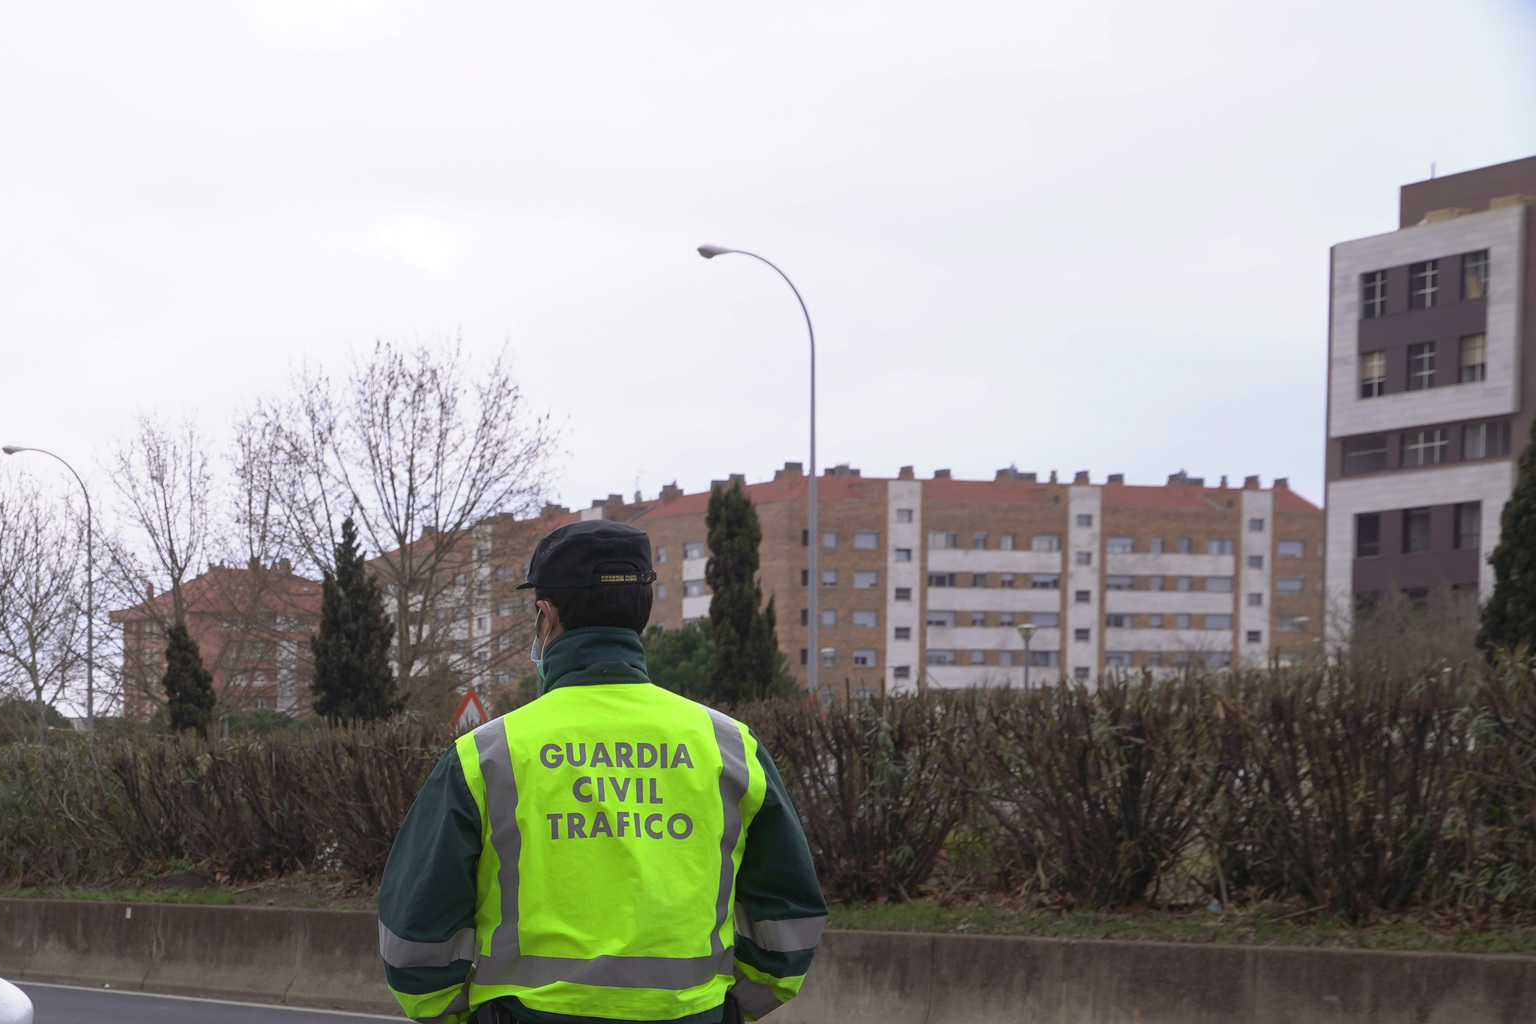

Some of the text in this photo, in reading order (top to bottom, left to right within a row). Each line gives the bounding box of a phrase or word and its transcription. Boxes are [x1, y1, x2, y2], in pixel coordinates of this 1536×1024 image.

[539, 742, 694, 769] GUARDIA
[572, 776, 663, 804] CIVIL
[546, 811, 694, 840] TRAFICO
